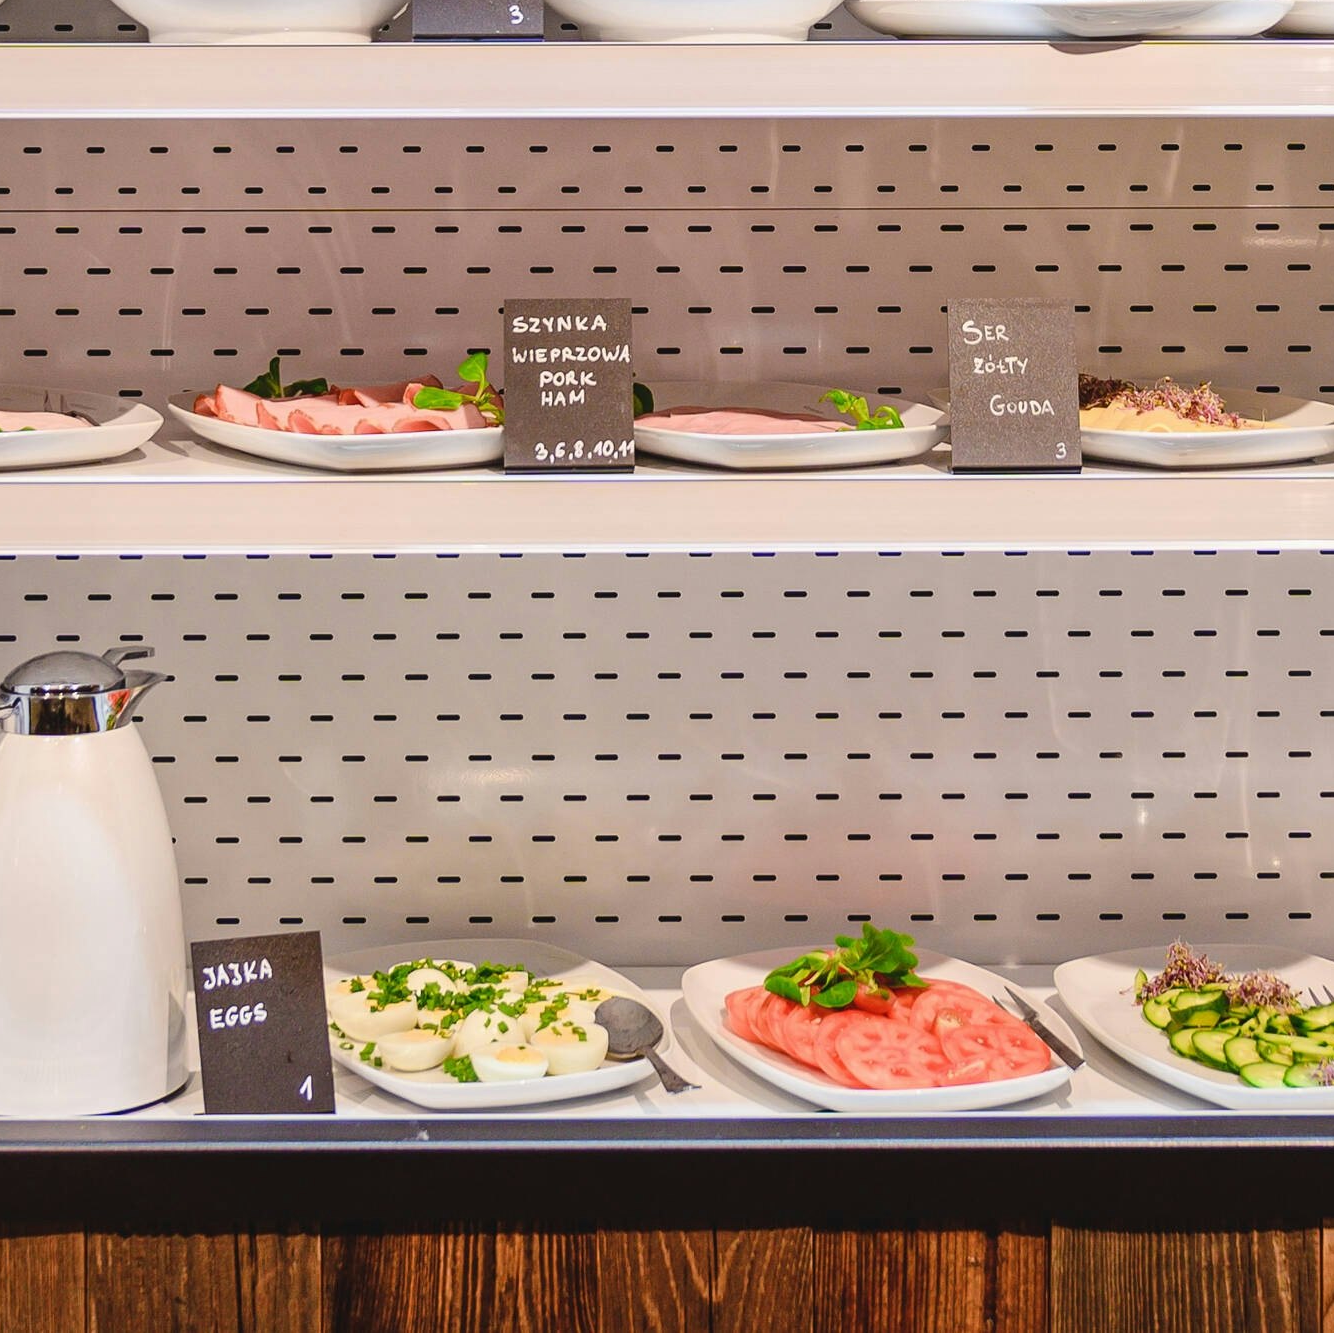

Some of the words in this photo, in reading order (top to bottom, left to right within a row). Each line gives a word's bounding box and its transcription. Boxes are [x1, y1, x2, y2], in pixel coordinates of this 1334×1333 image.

[509, 5, 524, 24] 3
[512, 314, 607, 333] SZYNKA
[962, 320, 1010, 345] SER
[512, 344, 631, 363] WIEPRZOWA
[539, 370, 597, 388] PORK
[541, 389, 585, 407] HAM
[989, 394, 1055, 416] GOUDA
[1055, 442, 1067, 459] 3
[202, 957, 273, 990] JAJKA
[209, 1002, 268, 1030] EGGS
[299, 1074, 313, 1101] 1
